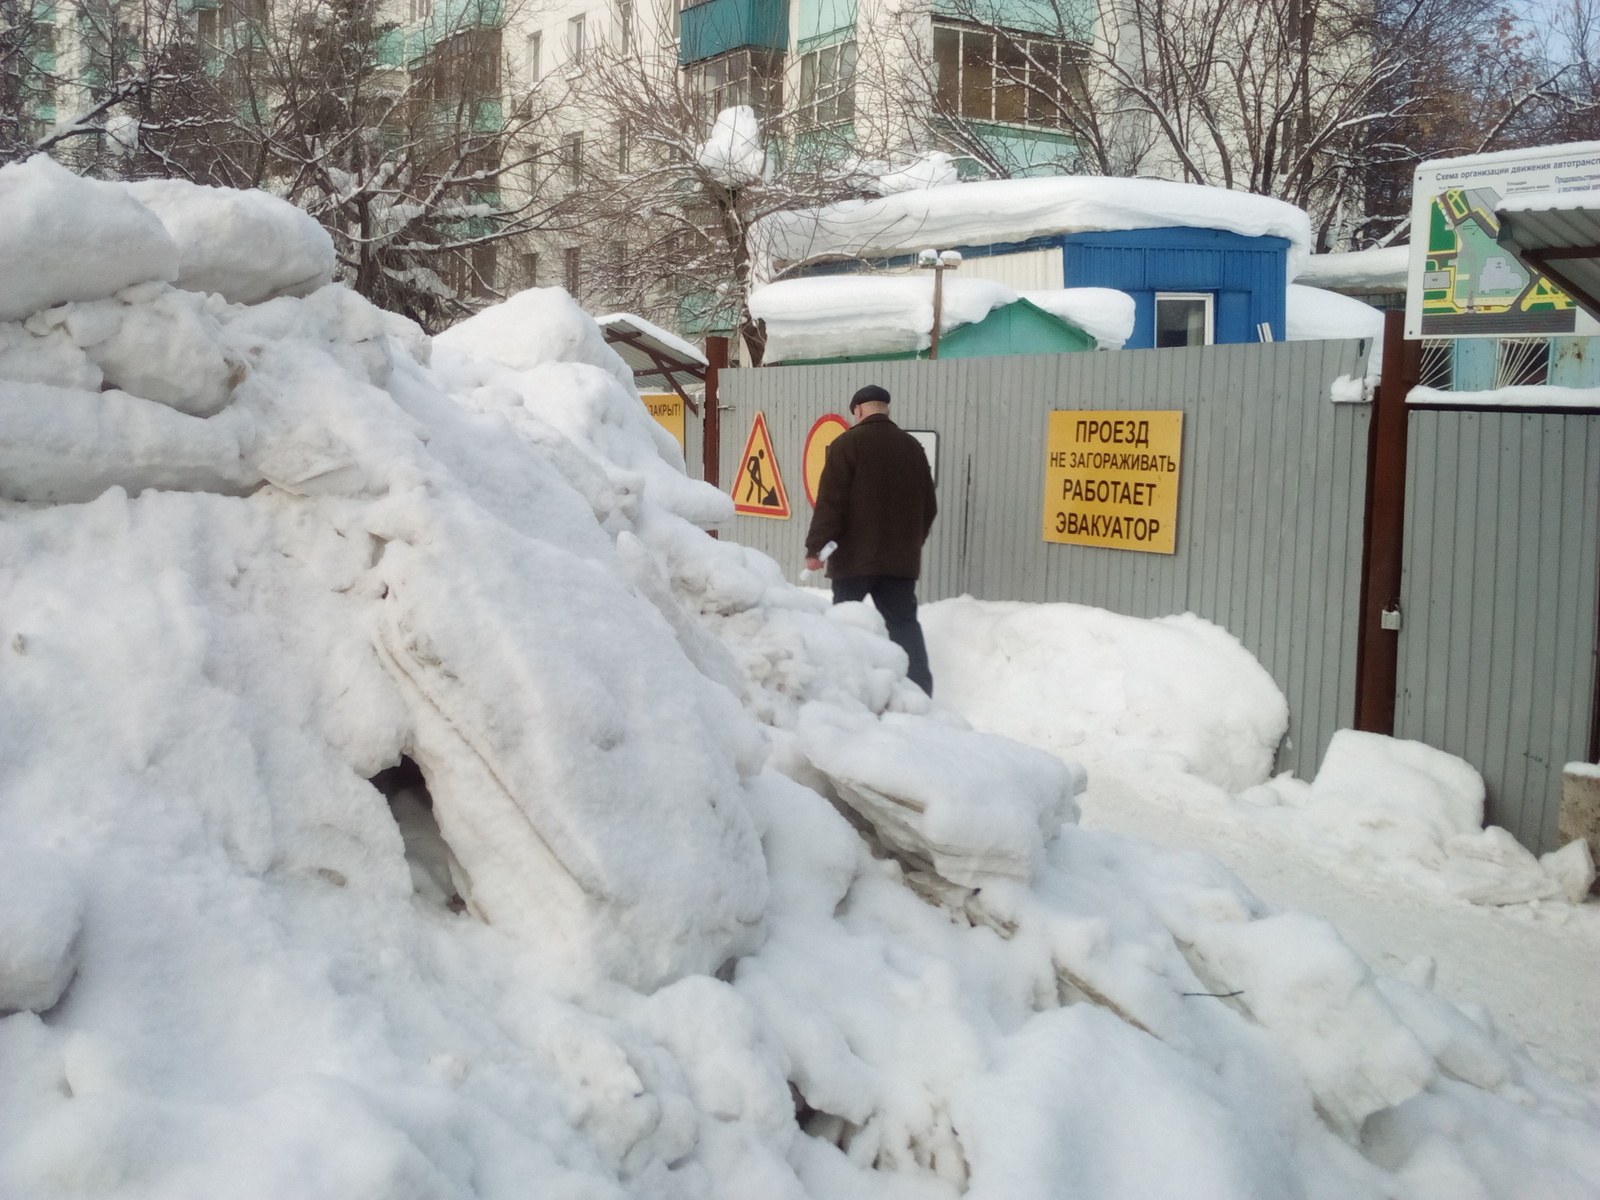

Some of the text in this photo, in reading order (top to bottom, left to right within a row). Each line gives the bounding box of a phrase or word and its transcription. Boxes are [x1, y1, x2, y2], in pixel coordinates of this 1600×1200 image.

[1436, 173, 1458, 181] Схема
[1461, 168, 1509, 180] организации
[1511, 163, 1551, 174] движения
[649, 403, 681, 416] ЗАКРЫТ!
[1075, 420, 1149, 448] ПРОЕЗД
[1050, 452, 1176, 472] НЕ ЗАГОРАЖИВАТЬ
[1062, 478, 1157, 506] РАБОТАЕТ
[1055, 511, 1160, 541] ЭВАКУАТОР
